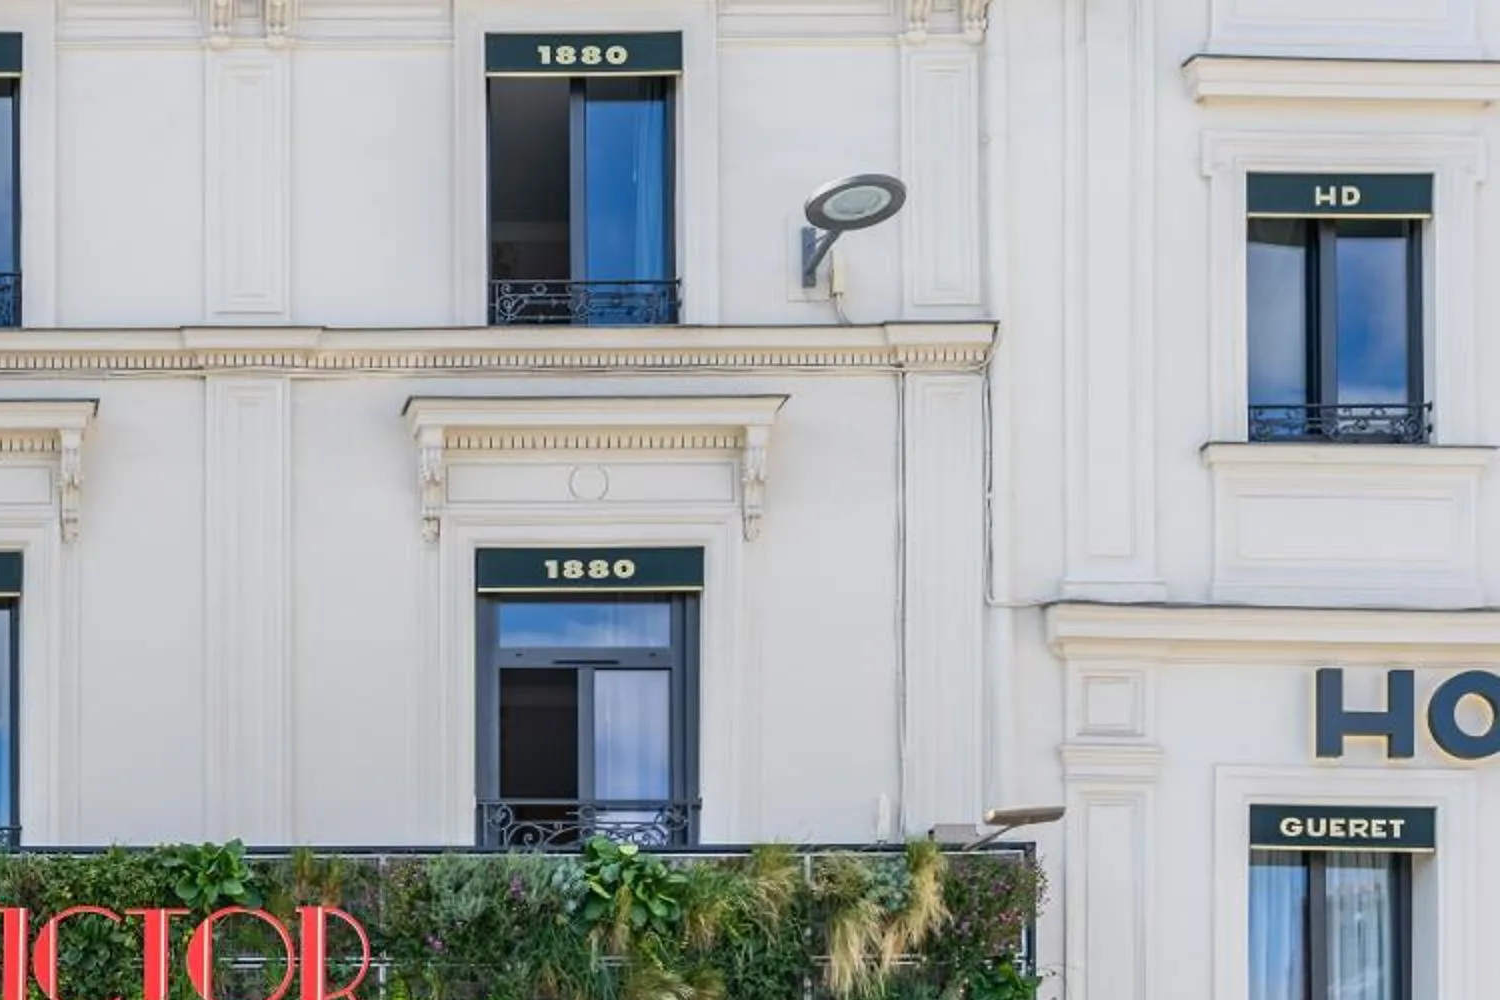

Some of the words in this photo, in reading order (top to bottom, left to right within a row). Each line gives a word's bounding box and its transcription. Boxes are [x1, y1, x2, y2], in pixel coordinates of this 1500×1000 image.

[537, 45, 629, 65] 1880
[1315, 185, 1361, 206] HD
[544, 559, 636, 580] 1880
[1316, 668, 1500, 761] HO
[1280, 817, 1405, 840] GUERET
